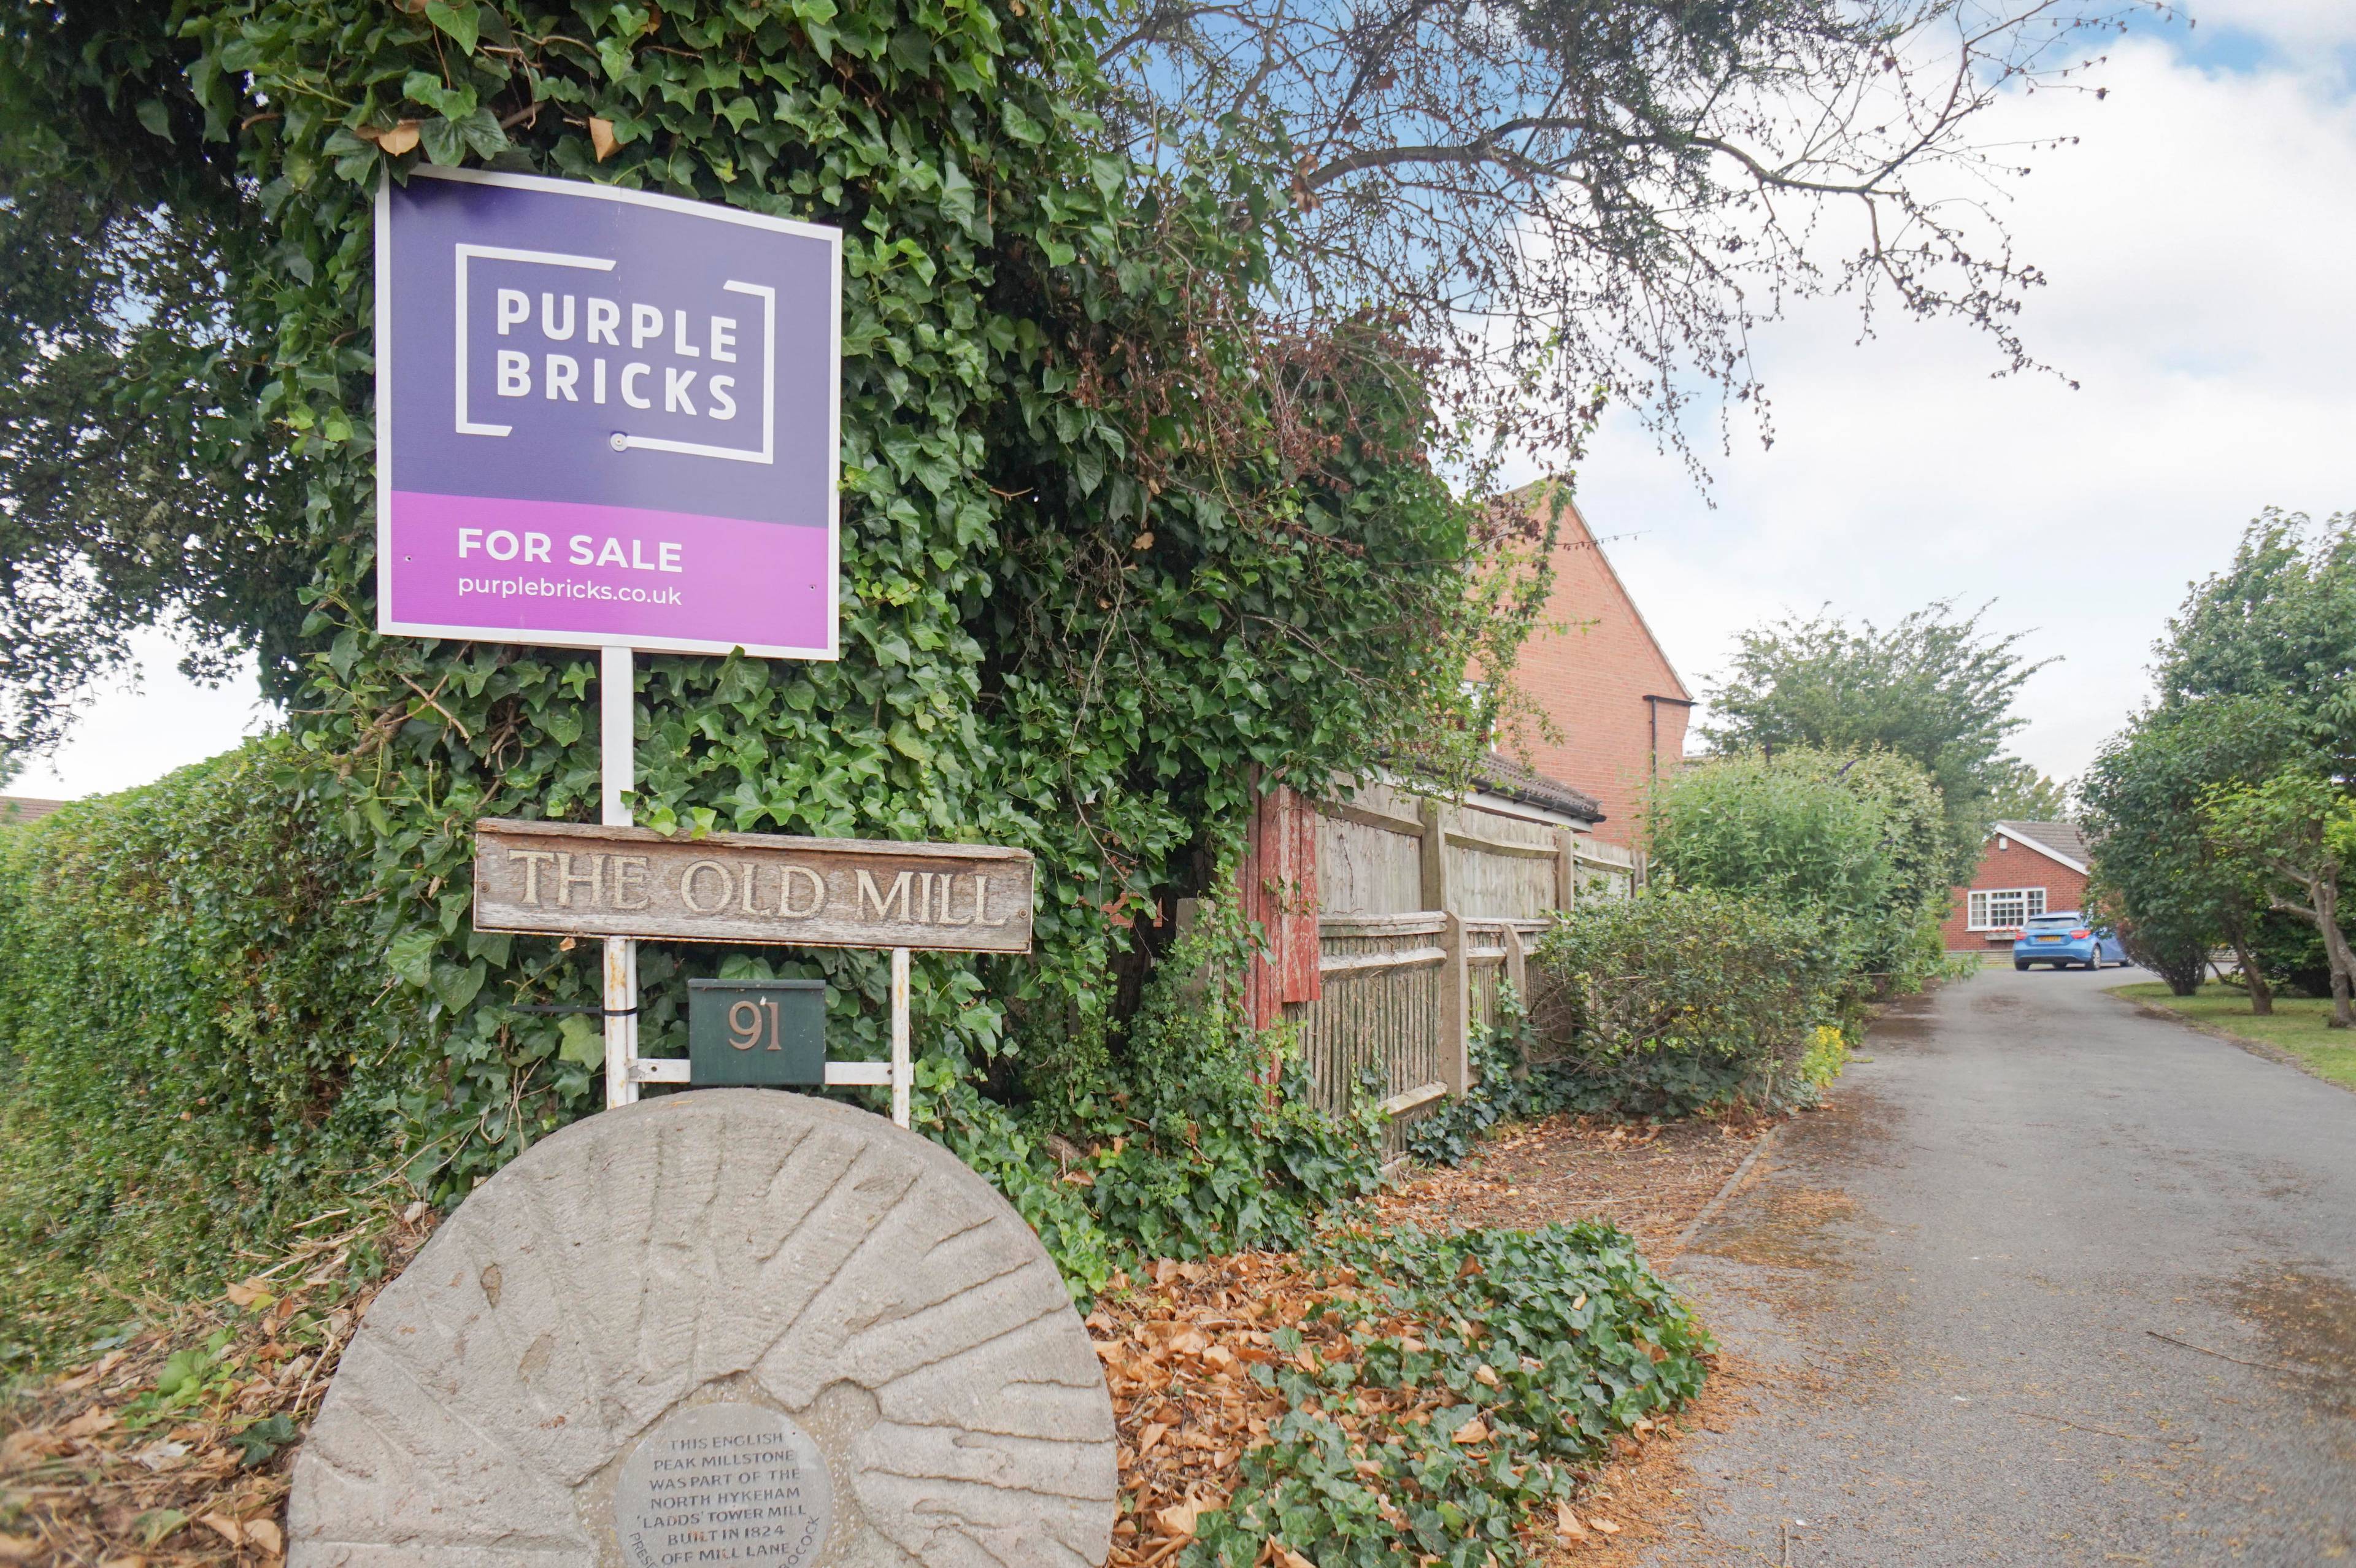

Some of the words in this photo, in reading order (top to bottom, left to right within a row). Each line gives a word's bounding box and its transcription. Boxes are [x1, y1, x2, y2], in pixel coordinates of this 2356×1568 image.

[498, 288, 737, 363] PURPLE
[498, 350, 737, 420] BRICKS
[458, 528, 552, 563] FOR
[569, 535, 682, 572] SALE
[458, 576, 682, 605] purplebricks.co.uk
[507, 849, 650, 909] THE
[680, 860, 828, 919] OLD
[855, 869, 1011, 927] MILL
[729, 1001, 782, 1050] 91
[671, 1438, 707, 1451] THIS
[712, 1432, 783, 1448] ENGLISH
[654, 1457, 696, 1471] PEAK
[702, 1450, 795, 1467] MILLSTONE
[649, 1477, 687, 1491] WAS
[691, 1474, 732, 1488] PART
[739, 1472, 761, 1485] OF
[769, 1467, 801, 1481] THE
[650, 1494, 710, 1509] NORTH
[718, 1487, 800, 1504] HYKEHAM
[708, 1507, 764, 1523] TOWER
[768, 1504, 806, 1518] MILL
[668, 1530, 718, 1546] BUILT
[722, 1528, 739, 1540] IN
[744, 1524, 785, 1539] 1824
[661, 1551, 693, 1565] OFF
[699, 1547, 740, 1561] MILL
[746, 1542, 791, 1559] LANE
